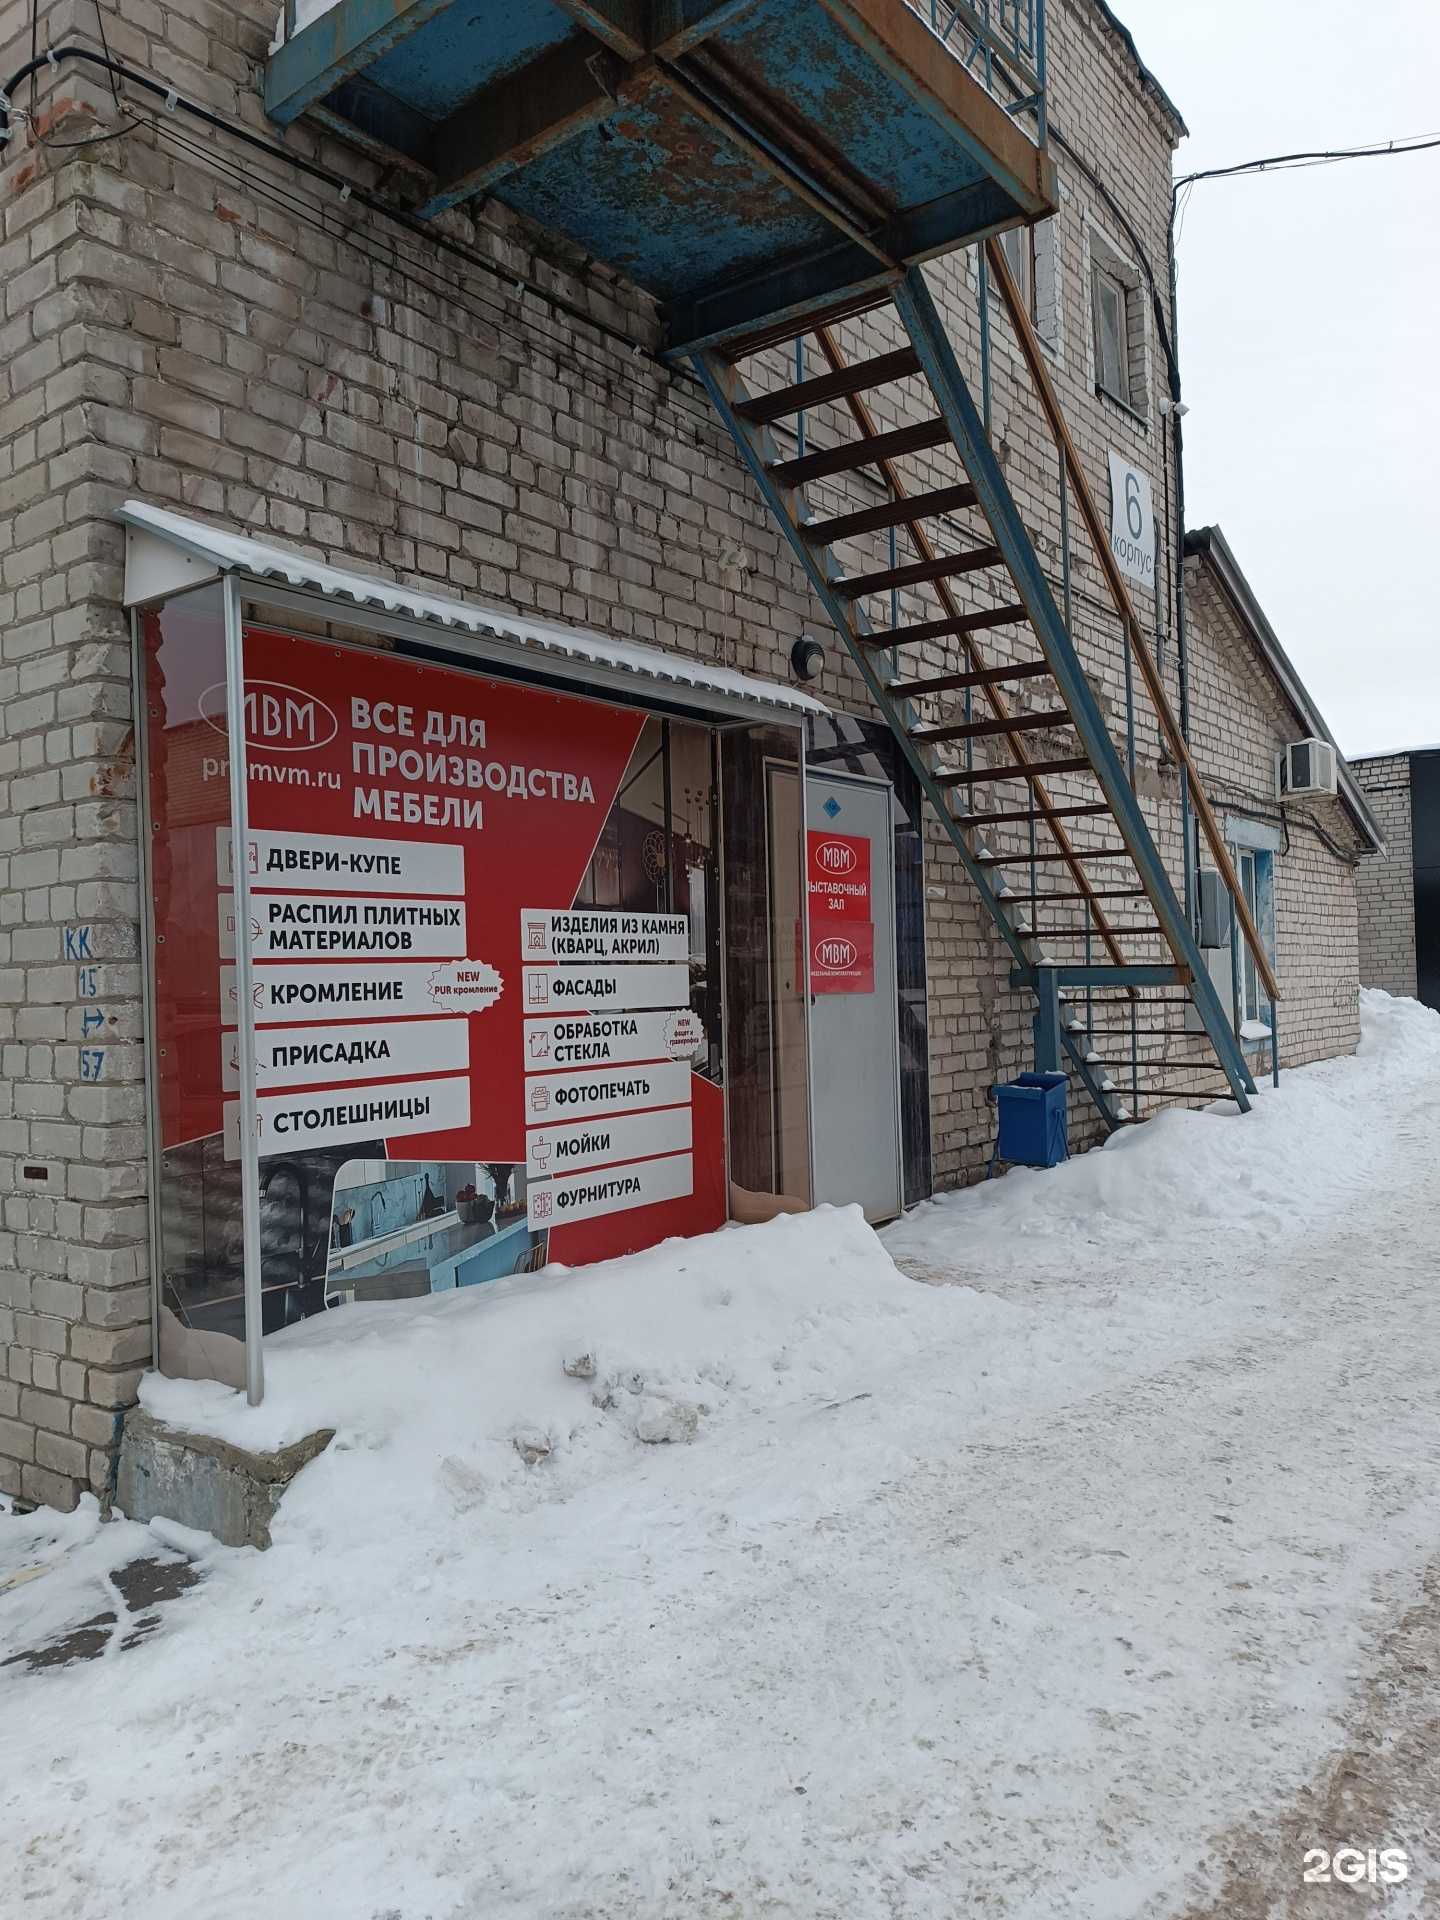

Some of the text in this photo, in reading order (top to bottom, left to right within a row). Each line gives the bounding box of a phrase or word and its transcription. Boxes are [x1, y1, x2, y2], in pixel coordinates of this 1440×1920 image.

[1125, 472, 1143, 540] 6
[1113, 534, 1152, 575] корпус
[351, 697, 487, 748] ВСЕ ДЛЯ
[202, 757, 341, 790] prmvm.ru
[352, 742, 596, 804] ПРОИЗВОДСТВА
[353, 788, 485, 830] МЕБЕЛИ
[266, 848, 402, 875] ДВЕРИ-КУПЕ
[268, 903, 461, 926] РАСПИЛ ПЛИТНЫХ
[828, 898, 845, 910] ЗАЛ
[551, 916, 685, 935] ИЗДЕЛИЯ ИЗ КАМНЯ
[268, 931, 412, 951] МАТЕРИАЛОВ
[551, 937, 660, 956] (КВАРЦ, АКРИЛ)
[80, 968, 97, 996] 15
[434, 985, 452, 995] PUR
[456, 971, 480, 982] NEW
[552, 979, 617, 997] ФАСАДЫ
[270, 981, 404, 1005] КРОМЛЕНИЕ
[553, 1019, 638, 1040] ОБРАБОТКА
[81, 1050, 104, 1081] 57
[272, 1039, 391, 1067] ПРИСАДКА
[554, 1042, 611, 1063] СТЕКЛА
[554, 1079, 650, 1106] ФОТОПЕЧАТЬ
[273, 1096, 431, 1134] СТОЛЕШНИЦЫ
[556, 1133, 611, 1159] МОЙКИ
[556, 1177, 641, 1209] ФУРНИТУРА
